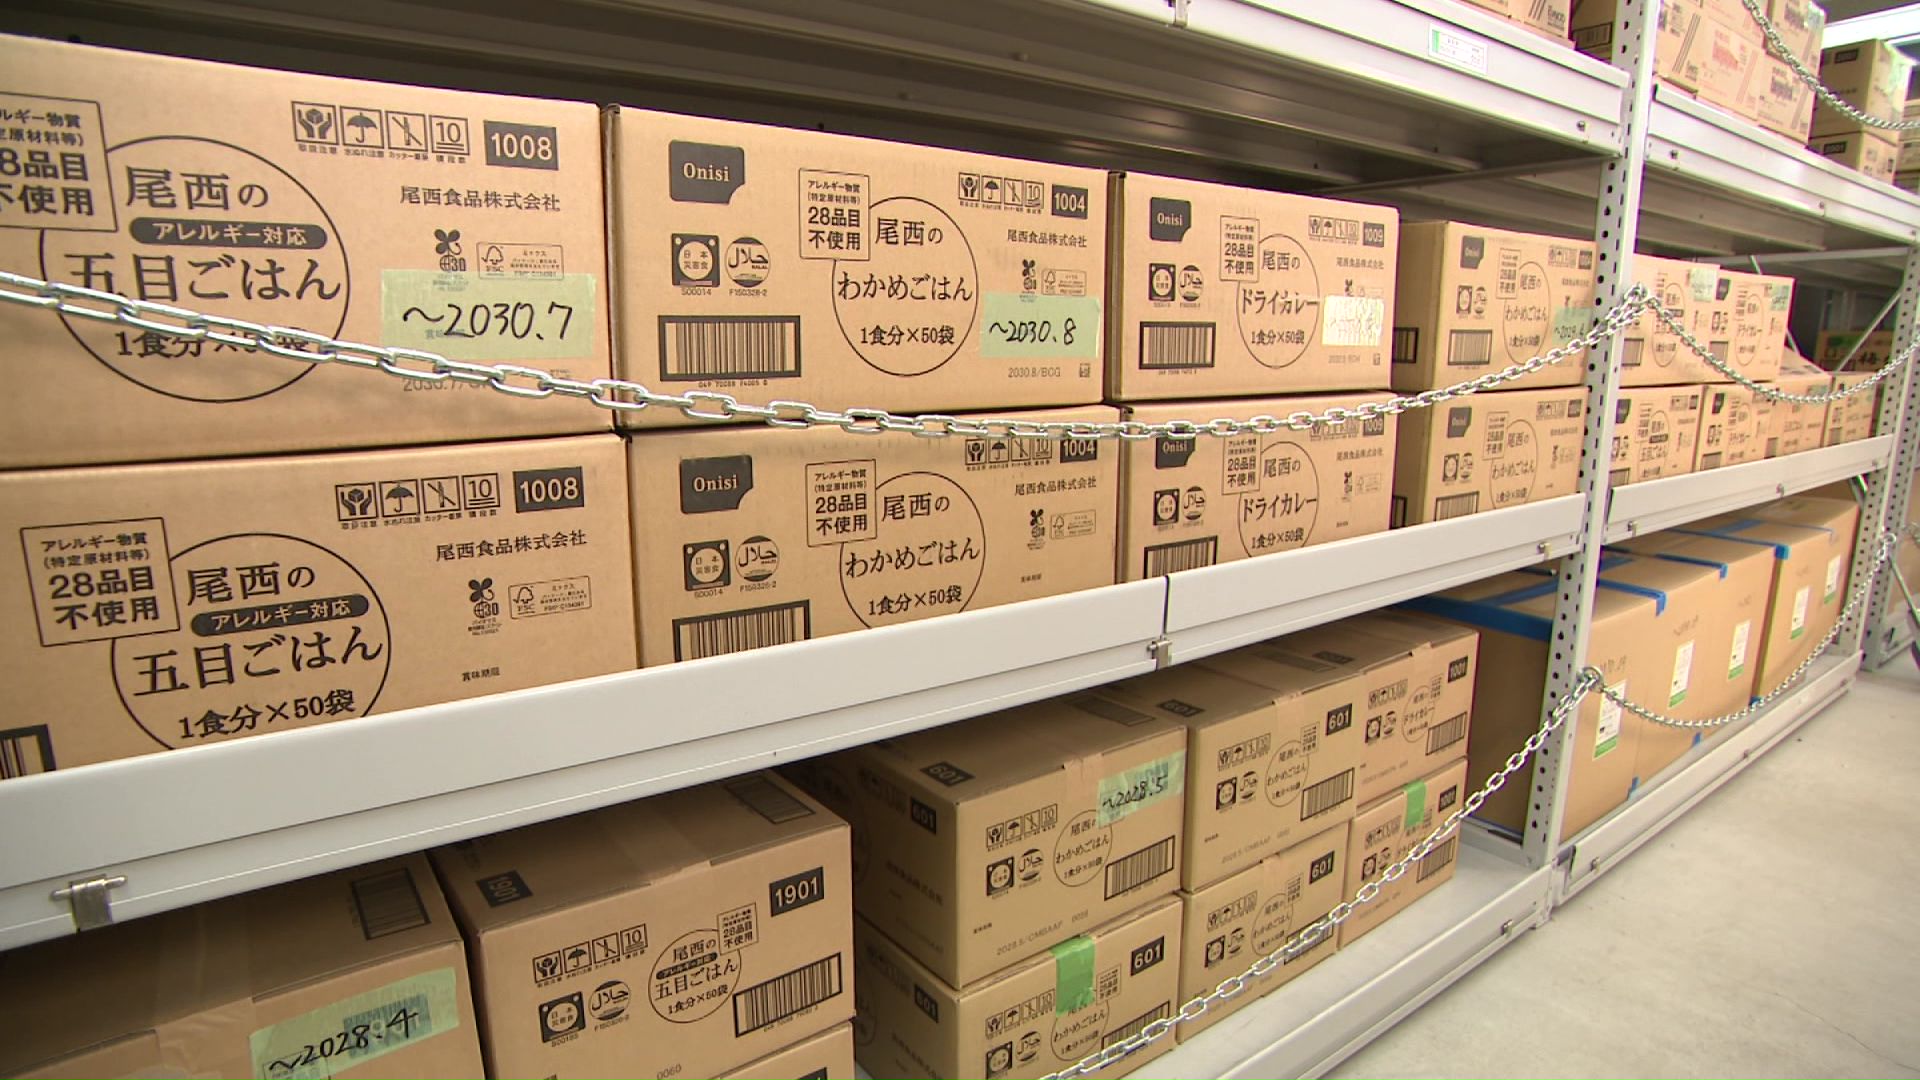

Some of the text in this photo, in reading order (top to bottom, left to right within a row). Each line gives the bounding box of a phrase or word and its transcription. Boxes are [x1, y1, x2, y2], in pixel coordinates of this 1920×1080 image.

[491, 133, 553, 161] 1008
[683, 162, 731, 183] Onisi
[126, 166, 269, 210] 尾西の
[400, 186, 561, 212] 尾西食品株式会社
[1054, 192, 1086, 213] 1004
[808, 206, 861, 228] 28品目
[1157, 212, 1184, 227] Onisi
[152, 221, 308, 246] アレルギー対応
[808, 229, 861, 251] 不使用
[875, 216, 944, 247] 尾西の
[1262, 250, 1301, 271] 尾西の
[64, 252, 341, 303] 五目ごはん
[838, 271, 973, 302] わかめごはん
[1242, 288, 1320, 315] ドライカレー
[860, 325, 955, 346] 1食分×50袋
[1063, 439, 1096, 457] 1004
[1163, 439, 1188, 454] Onisi
[1264, 457, 1301, 478] 尾西の
[520, 477, 579, 504] 1008
[694, 474, 738, 492] Onisi
[815, 493, 867, 514] 28品目
[882, 492, 950, 522] 尾西の
[1243, 493, 1317, 523] ドライカレー
[816, 514, 868, 536] 不使用
[41, 532, 148, 552] アレルギー物質
[436, 529, 588, 562] 尾西食品株式会社
[845, 537, 980, 578] わかめごはん
[48, 566, 154, 600] 28品目
[187, 561, 315, 608] 尾西の
[53, 596, 159, 631] 不使用
[868, 585, 962, 616] 1食分×50袋
[211, 599, 352, 631] アレルギー対応
[133, 626, 383, 697] 五目ごはん
[179, 689, 356, 740] 1食分×50袋
[1328, 709, 1350, 731] 601
[1312, 857, 1332, 878] 601
[776, 876, 819, 908] 1901
[673, 938, 717, 964] 尾西の
[1134, 943, 1162, 969] 601
[655, 958, 738, 1002] 五目ごはん
[1054, 1010, 1106, 1043] わかめごはん
